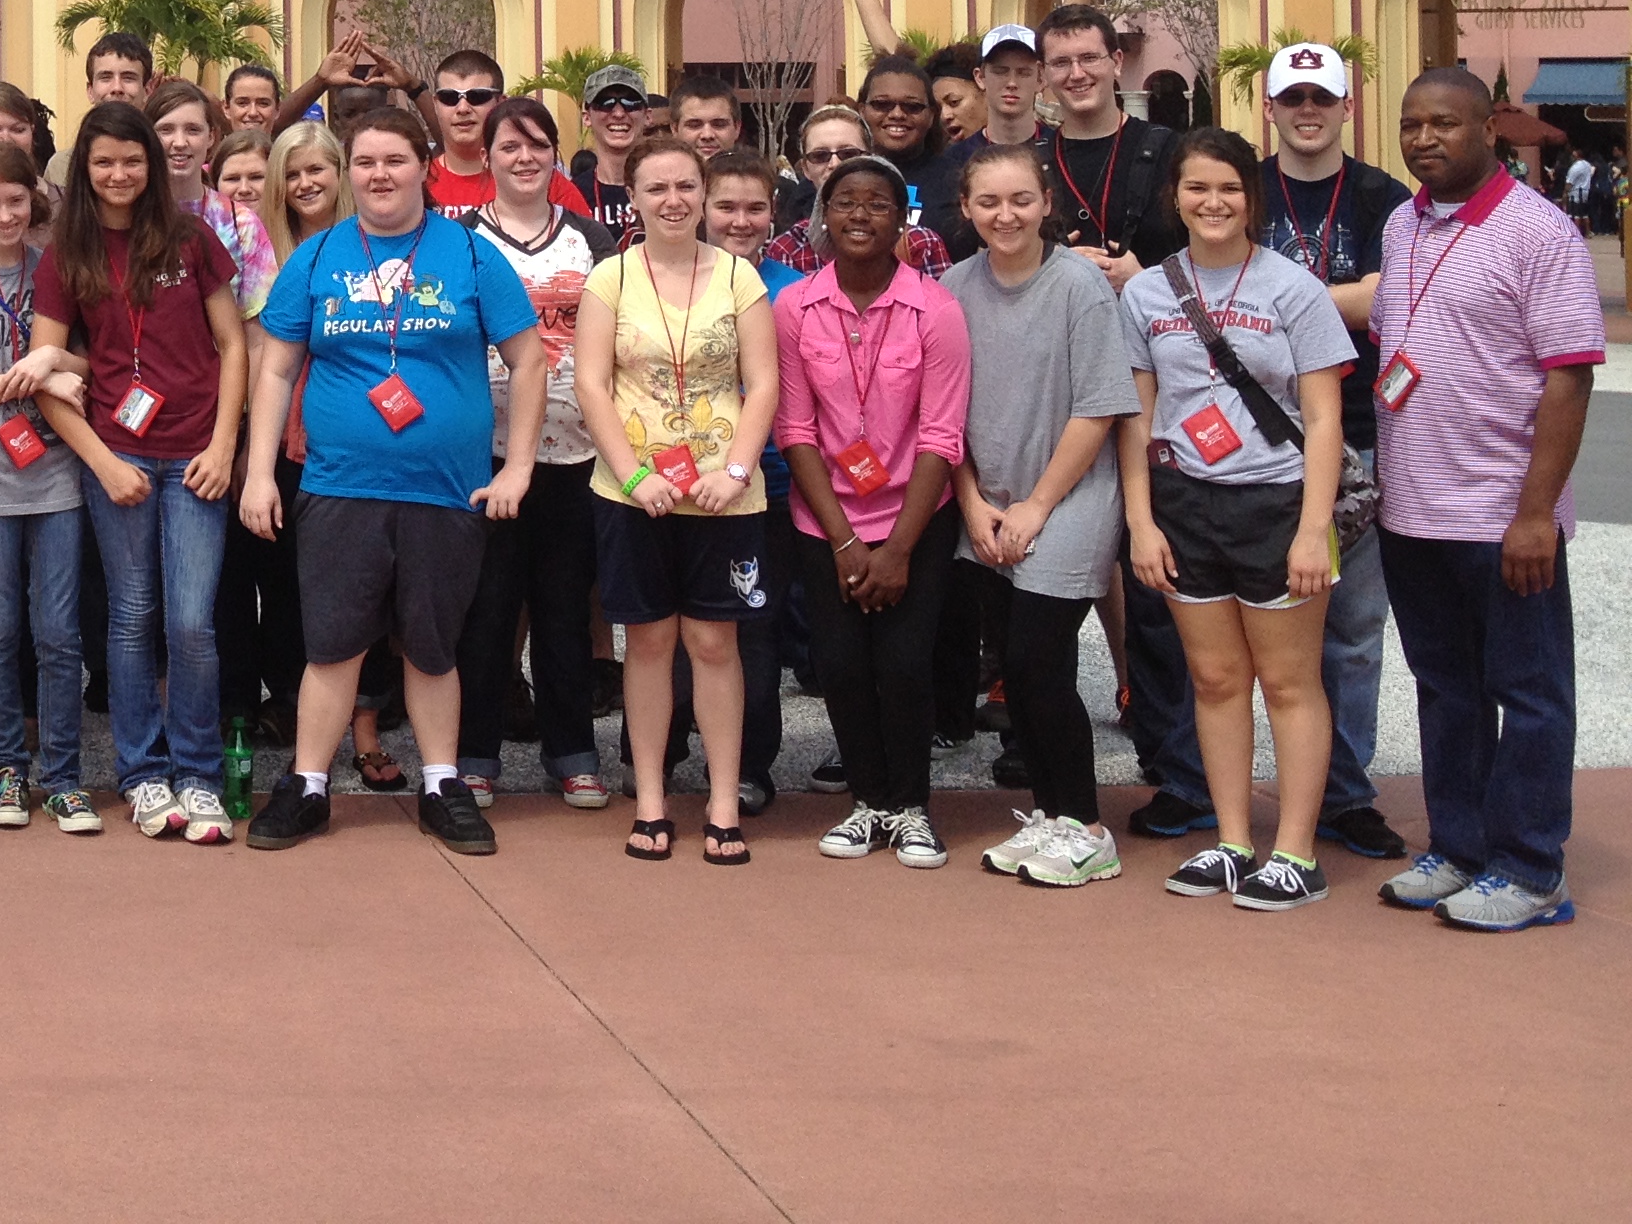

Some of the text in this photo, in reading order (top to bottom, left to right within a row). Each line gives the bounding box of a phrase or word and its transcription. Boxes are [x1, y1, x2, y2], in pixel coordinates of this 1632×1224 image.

[1524, 11, 1585, 29] SERVICES
[323, 317, 452, 337] REGULAR SHOW
[1226, 310, 1272, 335] BAND
